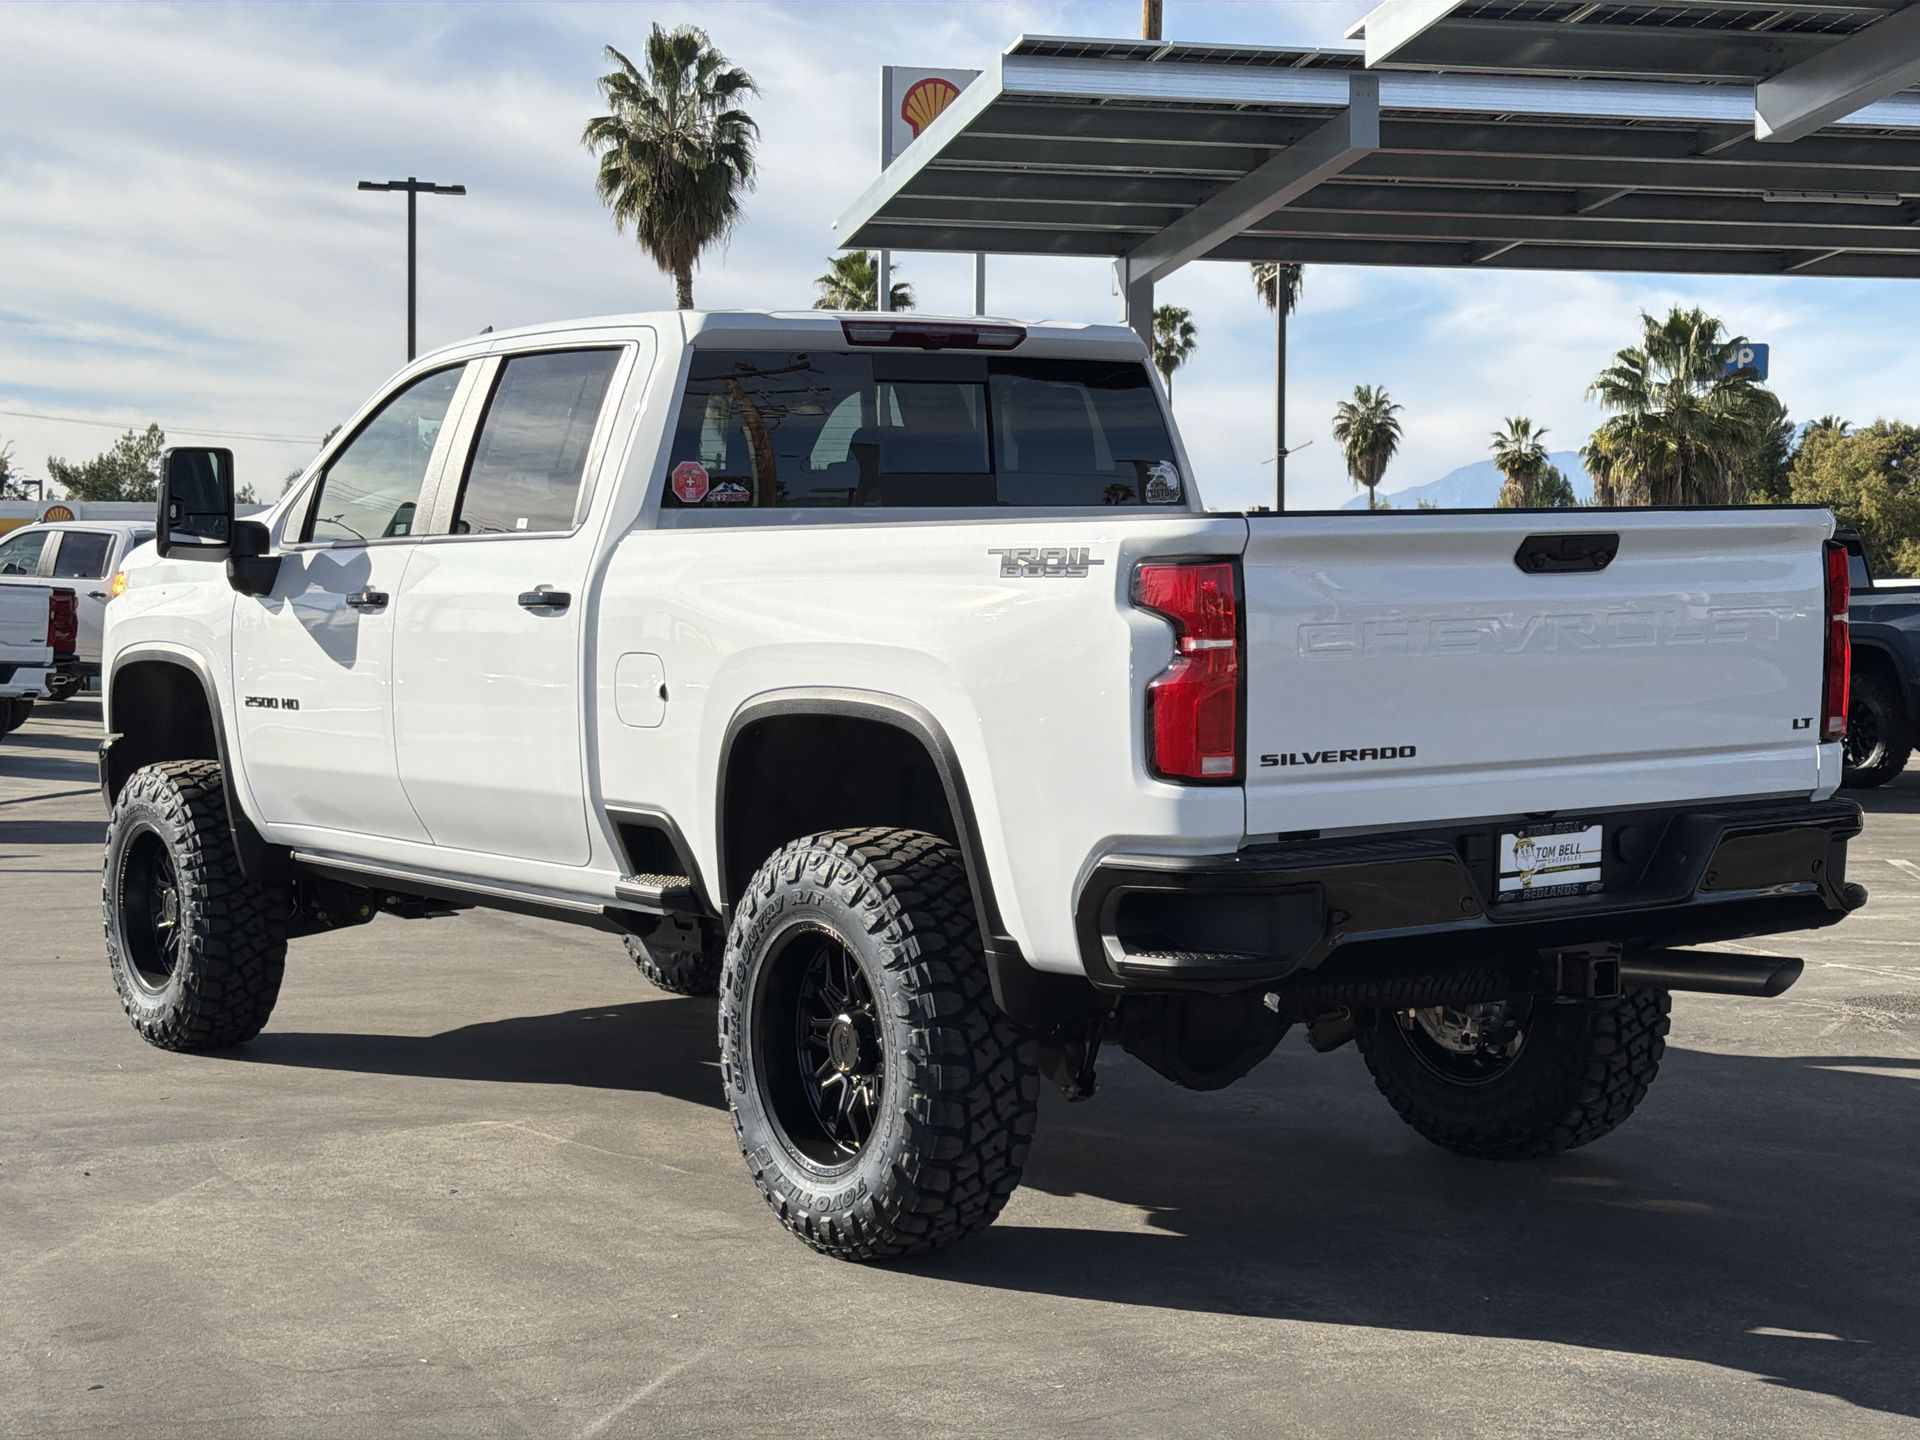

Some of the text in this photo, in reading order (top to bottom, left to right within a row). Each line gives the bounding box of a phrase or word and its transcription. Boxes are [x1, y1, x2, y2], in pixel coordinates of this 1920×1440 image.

[1147, 486, 1180, 499] CUSTOMS
[988, 547, 1105, 566] TRAIL
[1000, 564, 1089, 578] BOSS
[1297, 604, 1795, 660] CHEVROLET
[245, 696, 299, 710] 2500 HD
[1792, 717, 1813, 730] LT
[1260, 745, 1416, 767] SILVERADO
[1536, 842, 1582, 859] TOM BELL
[1548, 854, 1582, 864] CHEVROLET
[791, 888, 825, 907] R/T
[1523, 883, 1580, 900] REDLANDS
[733, 894, 785, 1002] COUNTRY
[730, 1004, 747, 1095] OPEN
[754, 1144, 814, 1209] TIRES
[815, 1176, 868, 1213] TOYO
